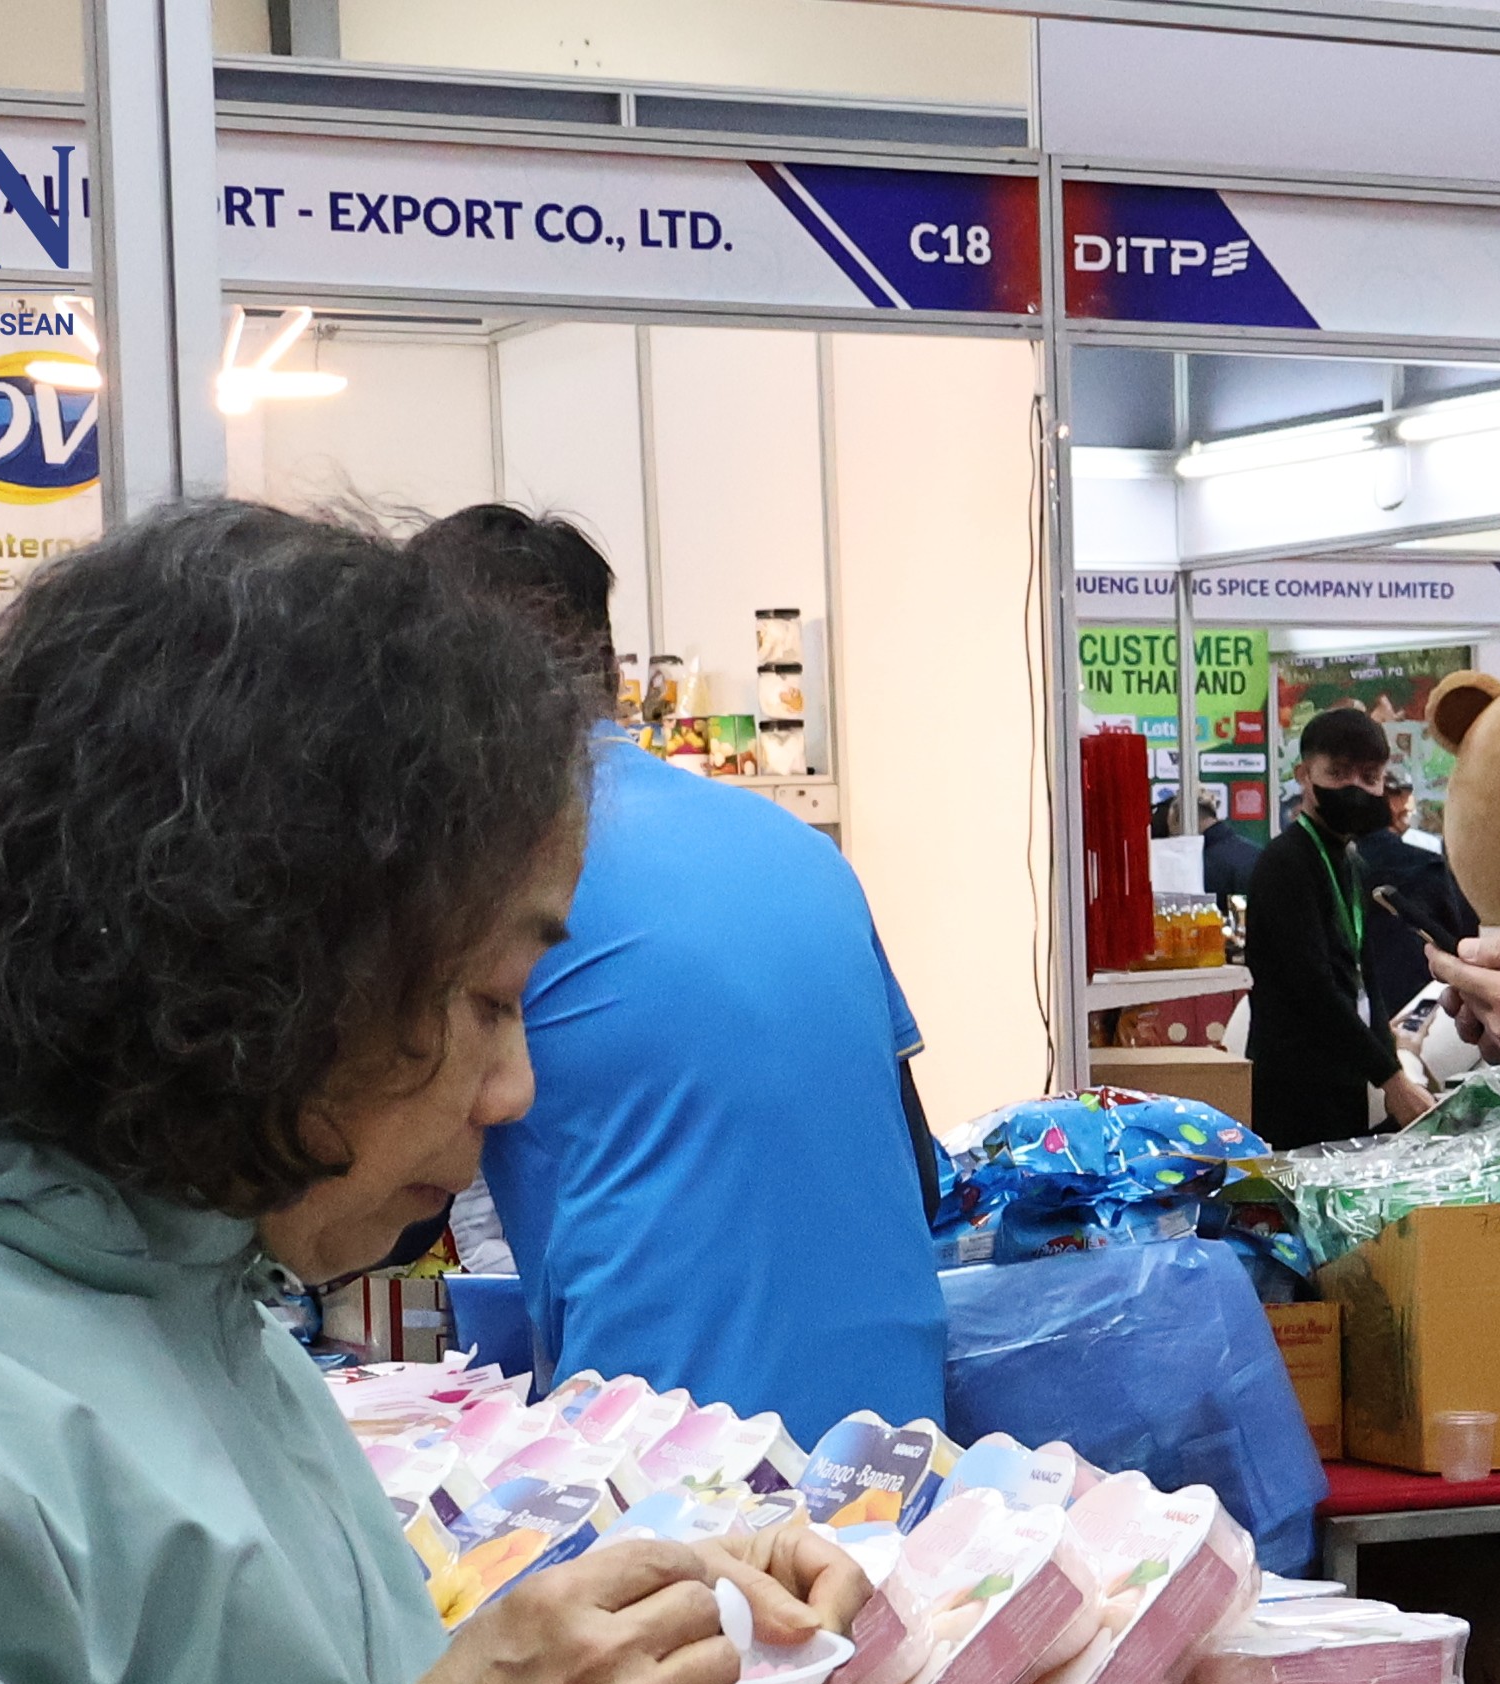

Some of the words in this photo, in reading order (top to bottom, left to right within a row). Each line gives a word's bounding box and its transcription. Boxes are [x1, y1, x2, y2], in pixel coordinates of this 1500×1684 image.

[328, 192, 519, 243] EXPORT
[535, 203, 626, 255] CO.,
[638, 207, 734, 253] LTD.
[909, 222, 992, 266] C18
[1217, 578, 1269, 598] SPICE
[1275, 579, 1374, 600] COMPANY
[1377, 580, 1455, 600] LIMITED
[813, 1456, 854, 1484] Mango
